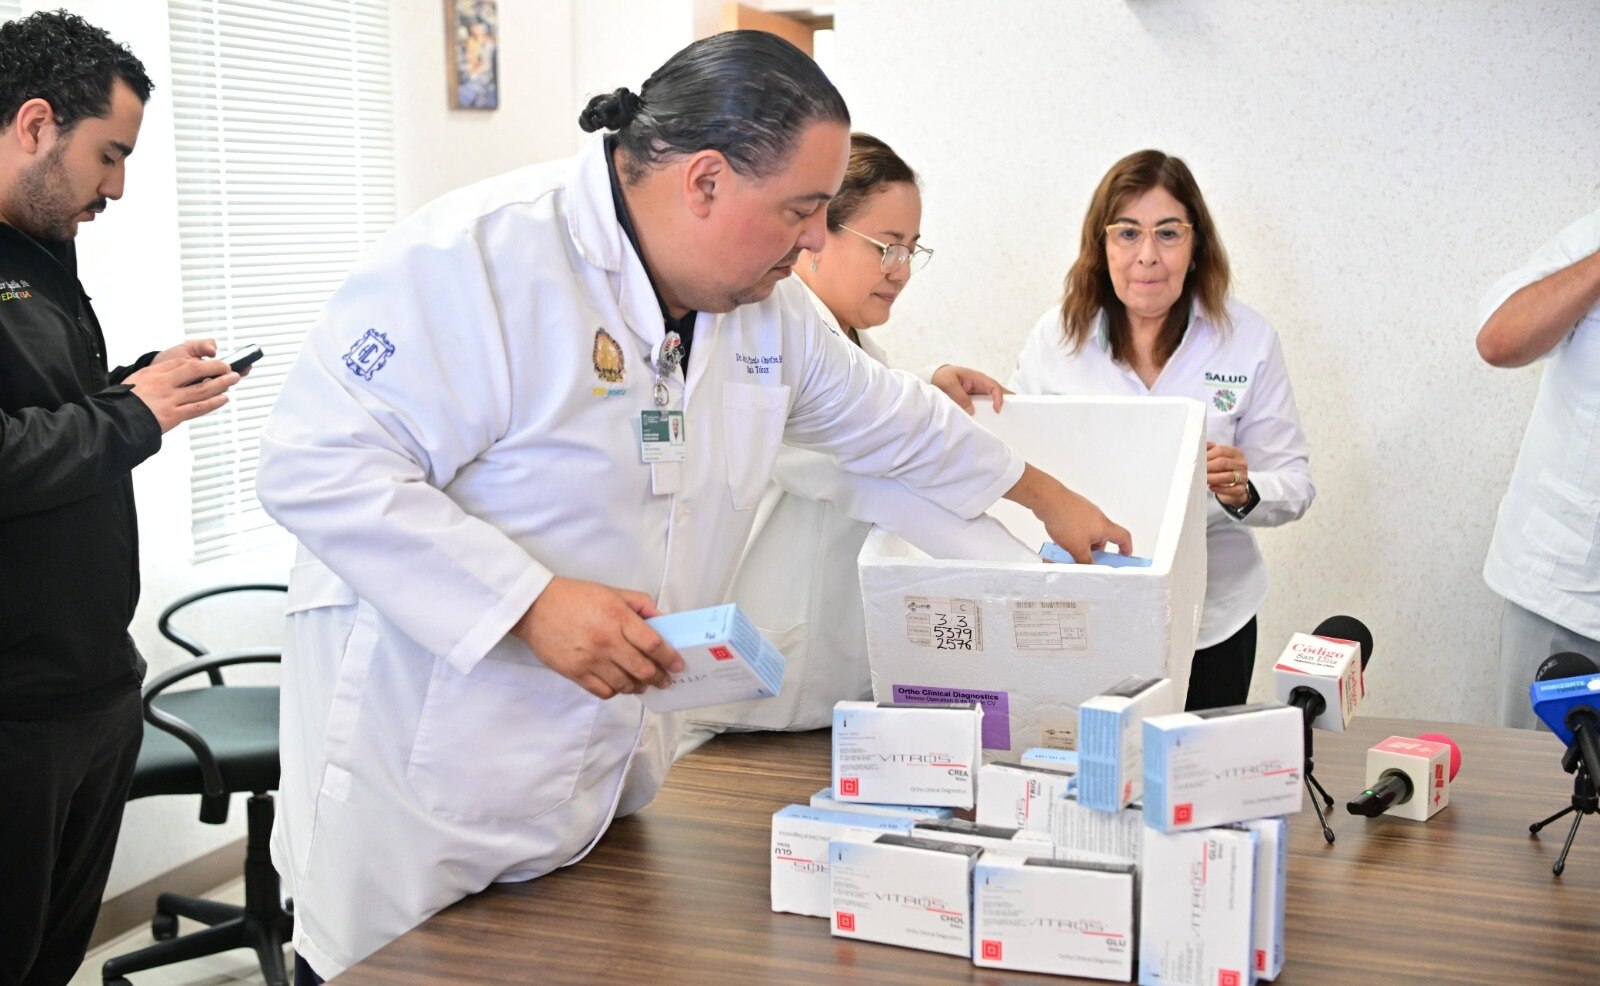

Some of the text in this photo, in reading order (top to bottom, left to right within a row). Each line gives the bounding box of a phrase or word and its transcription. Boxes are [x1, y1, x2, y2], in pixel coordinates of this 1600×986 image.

[1204, 372, 1248, 383] SALUD
[956, 615, 968, 628] 3
[933, 626, 972, 640] 5379
[936, 638, 972, 651] 2576
[1292, 643, 1345, 660] Código
[1296, 652, 1338, 665] San Luis
[898, 687, 999, 701] Ortho Clinical Diagnostics
[880, 752, 951, 764] VITROS
[947, 768, 969, 777] CREA
[1029, 779, 1037, 799] TRIG
[774, 848, 792, 856] GLU
[1208, 839, 1218, 861] GLU
[875, 892, 946, 909] VITROS
[940, 914, 965, 925] CHOL
[1105, 938, 1126, 947] GLU
